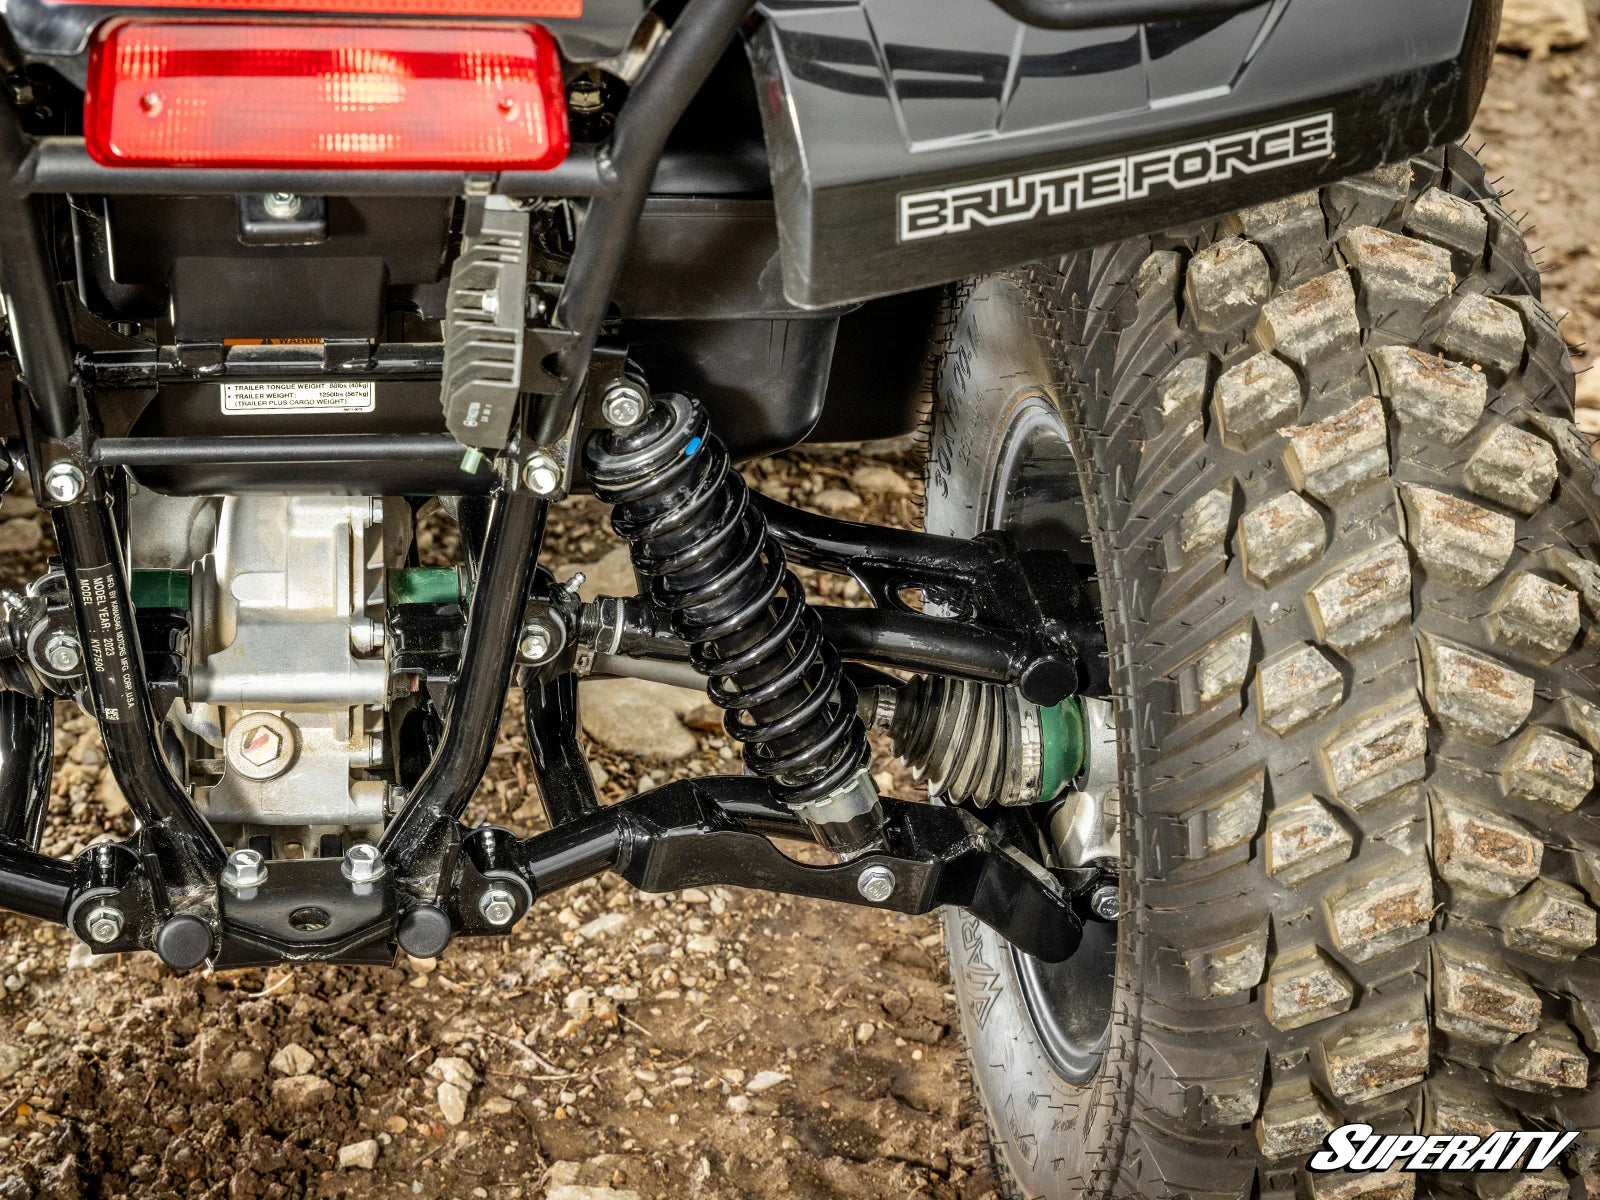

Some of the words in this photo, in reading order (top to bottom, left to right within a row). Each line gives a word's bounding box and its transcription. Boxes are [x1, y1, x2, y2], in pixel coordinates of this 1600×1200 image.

[280, 337, 323, 345] WARNI
[109, 590, 117, 599] BY
[80, 579, 93, 606] MODEL
[91, 639, 105, 672] KVF750G
[93, 577, 107, 606] MODEL
[103, 637, 115, 657] 2023
[111, 600, 122, 631] KAWASAKI
[116, 631, 127, 657] MOTORS
[120, 657, 129, 672] MFG.
